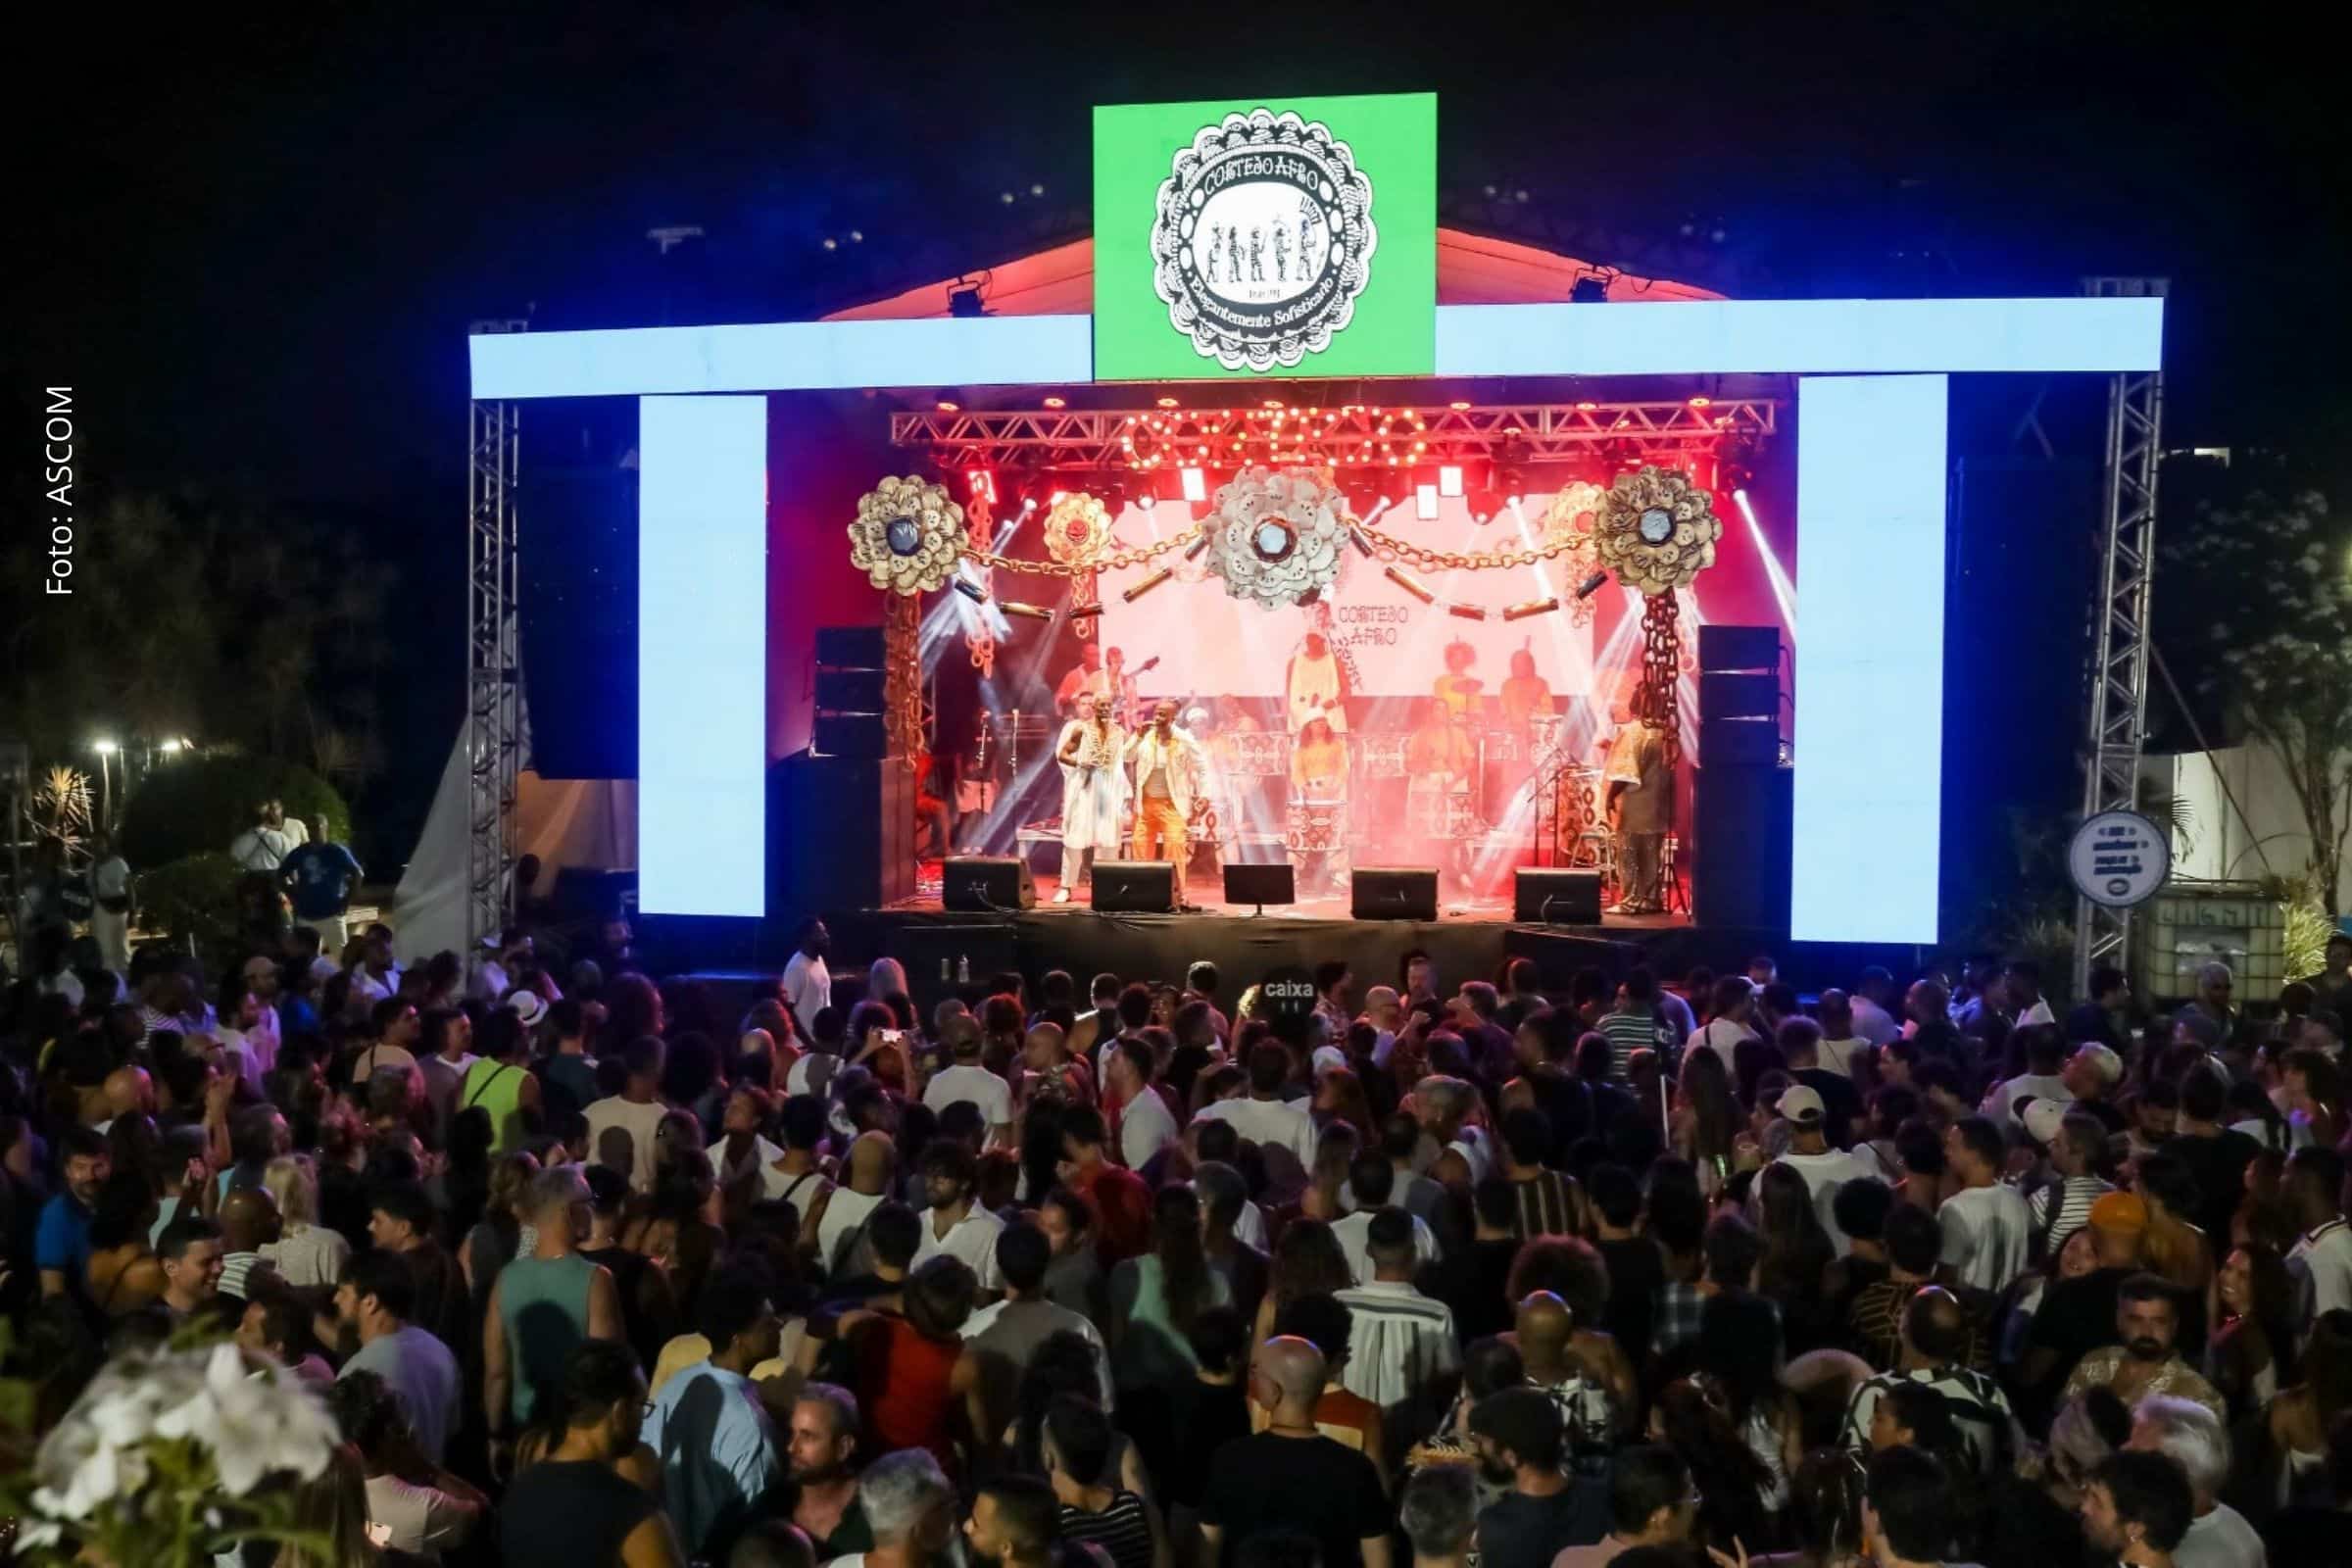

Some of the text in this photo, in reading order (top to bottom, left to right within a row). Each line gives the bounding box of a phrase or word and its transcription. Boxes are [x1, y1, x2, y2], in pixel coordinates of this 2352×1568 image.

[1190, 274, 1335, 328] Elegantemente Sofisticado
[1264, 979, 1314, 997] caixa
